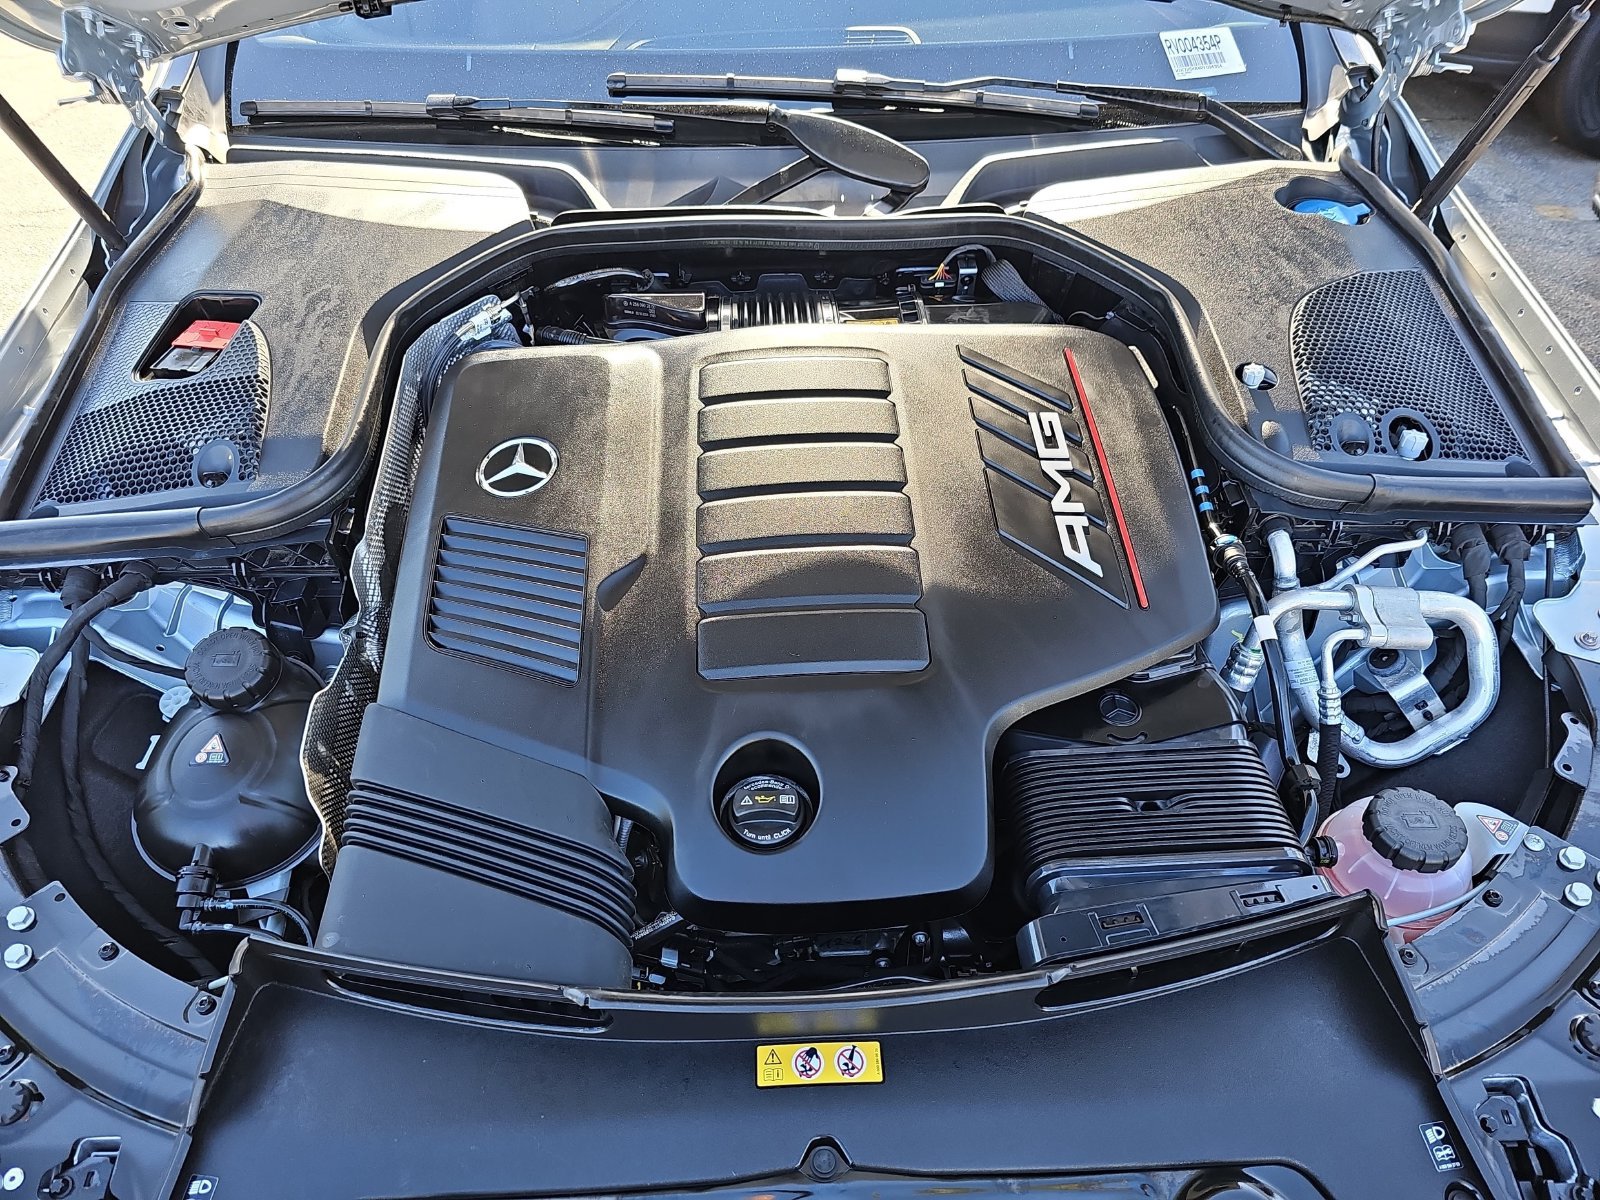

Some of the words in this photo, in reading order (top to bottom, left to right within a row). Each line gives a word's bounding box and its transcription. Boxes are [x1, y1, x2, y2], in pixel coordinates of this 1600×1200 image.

[1164, 34, 1221, 55] RV004354P
[1028, 412, 1103, 577] AMG
[1393, 792, 1413, 800] OPEN
[743, 829, 756, 839] Turn
[773, 827, 791, 840] CLICK
